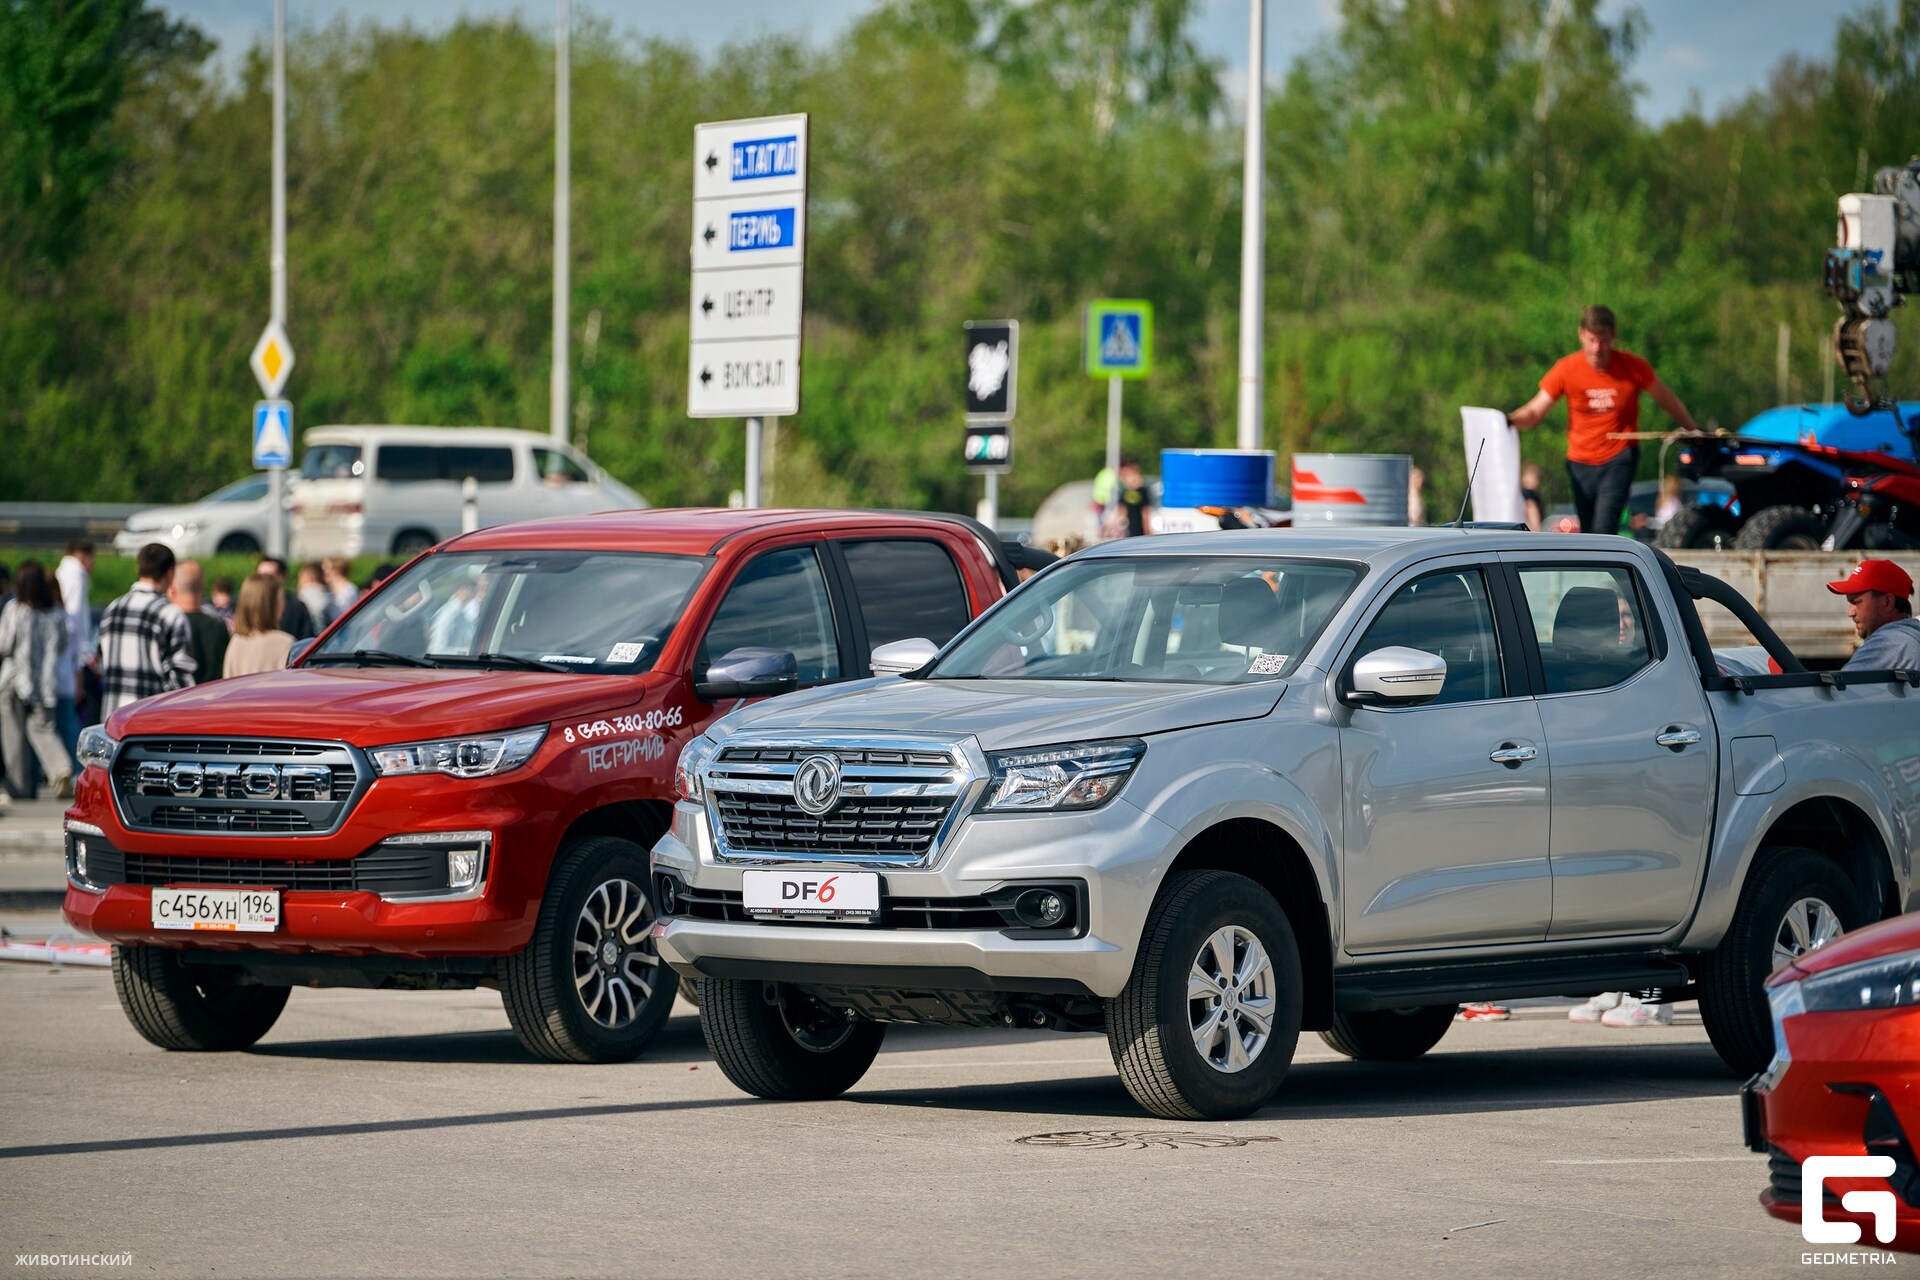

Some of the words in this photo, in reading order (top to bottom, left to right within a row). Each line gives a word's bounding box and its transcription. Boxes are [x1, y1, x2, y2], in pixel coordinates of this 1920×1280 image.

[730, 214, 782, 248] ПЕРМЬ
[724, 288, 775, 318] ЦЕНТР
[722, 359, 785, 389] ВОКЗАЛ
[564, 727, 576, 743] 8
[612, 705, 683, 733] 380-80-66
[243, 895, 273, 914] 196
[782, 876, 840, 903] DF6
[248, 914, 264, 922] RUS
